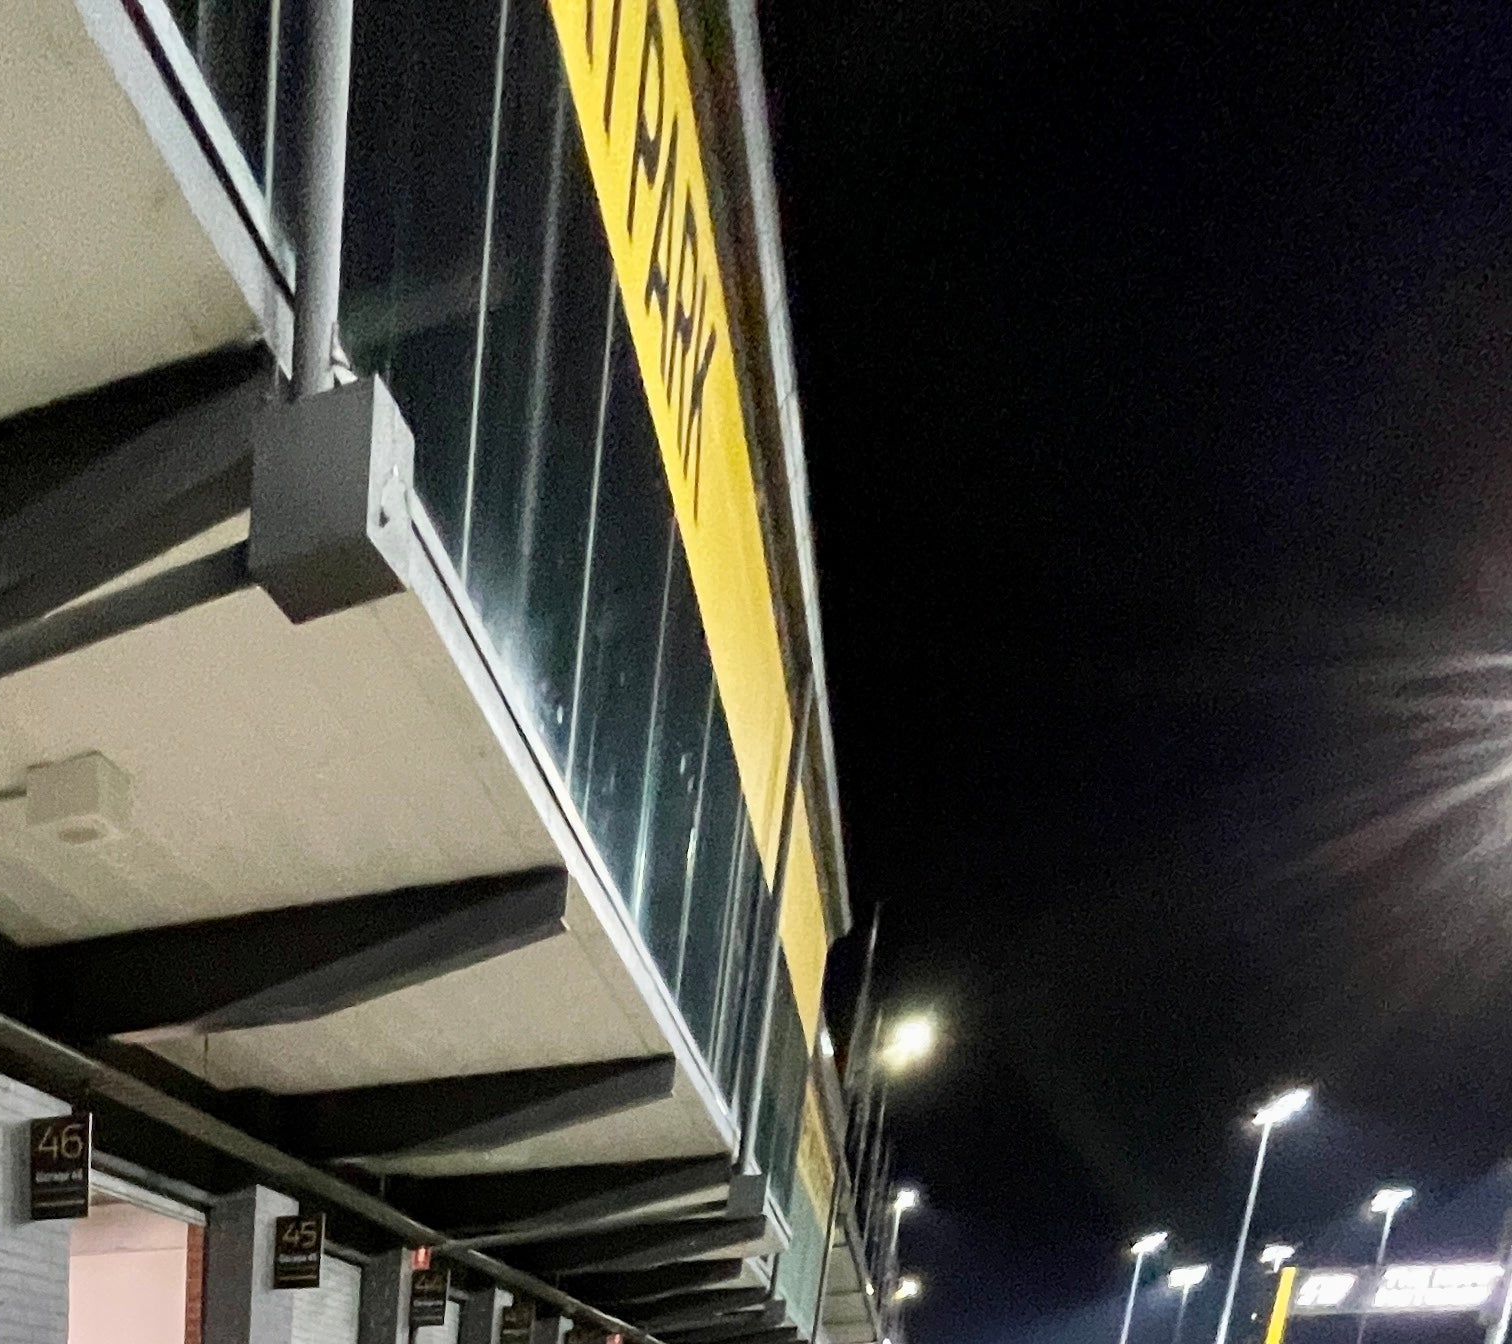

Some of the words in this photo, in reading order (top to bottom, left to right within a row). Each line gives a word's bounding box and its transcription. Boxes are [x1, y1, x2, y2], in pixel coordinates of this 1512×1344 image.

[627, 2, 716, 526] PARK
[38, 1124, 83, 1160] 46
[282, 1221, 317, 1249] 45
